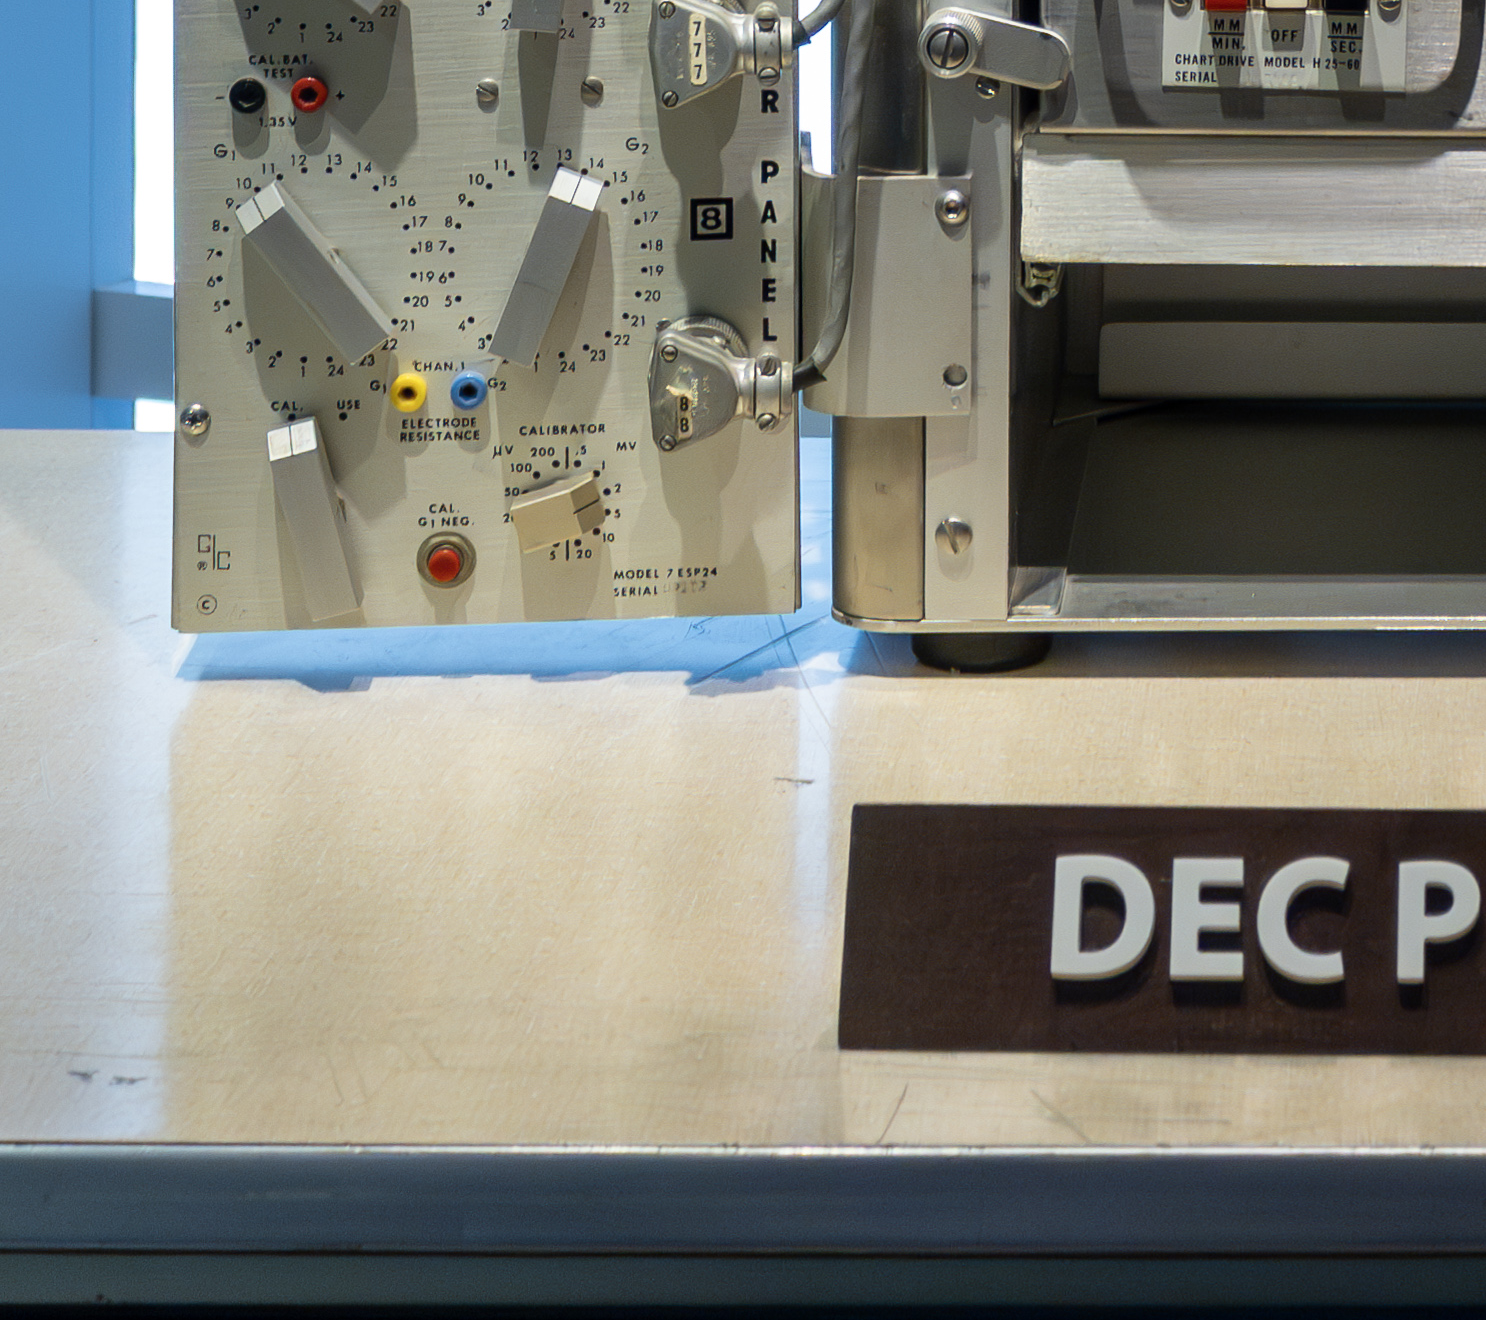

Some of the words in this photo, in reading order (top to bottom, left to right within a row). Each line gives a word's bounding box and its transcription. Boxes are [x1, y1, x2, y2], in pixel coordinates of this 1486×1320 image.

[1270, 28, 1298, 43] OFF
[1174, 53, 1215, 67] CHART
[1218, 54, 1255, 68] DRIVE
[1264, 56, 1305, 69] MODEL
[262, 66, 294, 78] TEST
[1174, 70, 1218, 84] SERIAL
[757, 159, 781, 344] PANEL
[336, 398, 361, 411] USE
[401, 417, 478, 429] ELECTRODE
[399, 430, 480, 442] RESISTANCE
[518, 423, 606, 437] CALIBRATOR
[530, 446, 555, 458] 200
[613, 569, 659, 581] MODEL
[1049, 853, 1350, 987] DEC
